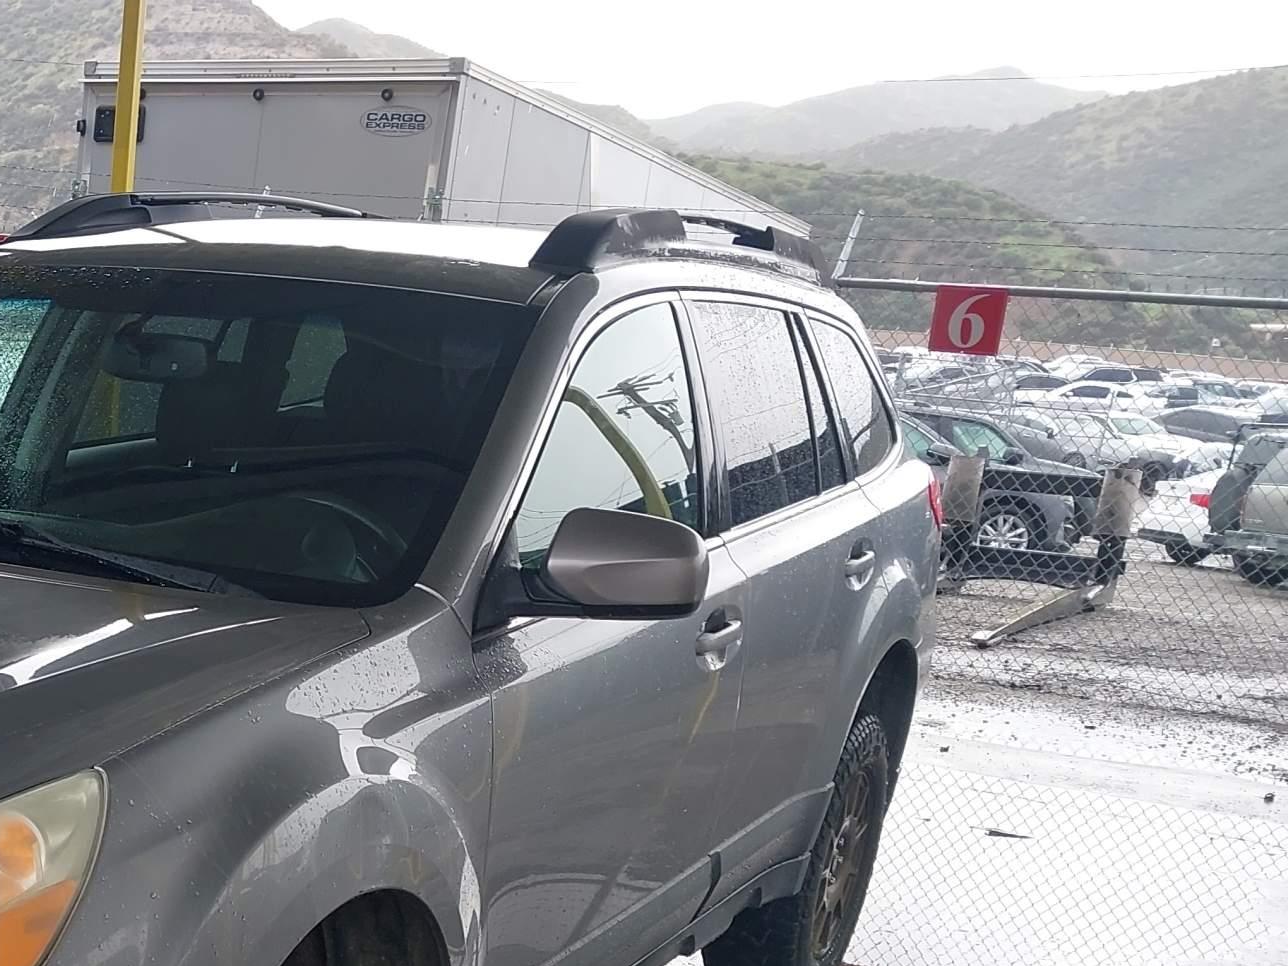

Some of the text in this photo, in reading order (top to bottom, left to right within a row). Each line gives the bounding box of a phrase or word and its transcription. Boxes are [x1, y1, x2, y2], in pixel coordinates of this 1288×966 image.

[366, 112, 426, 123] CARGO
[365, 122, 425, 130] EXPRESS
[948, 293, 992, 348] 6
